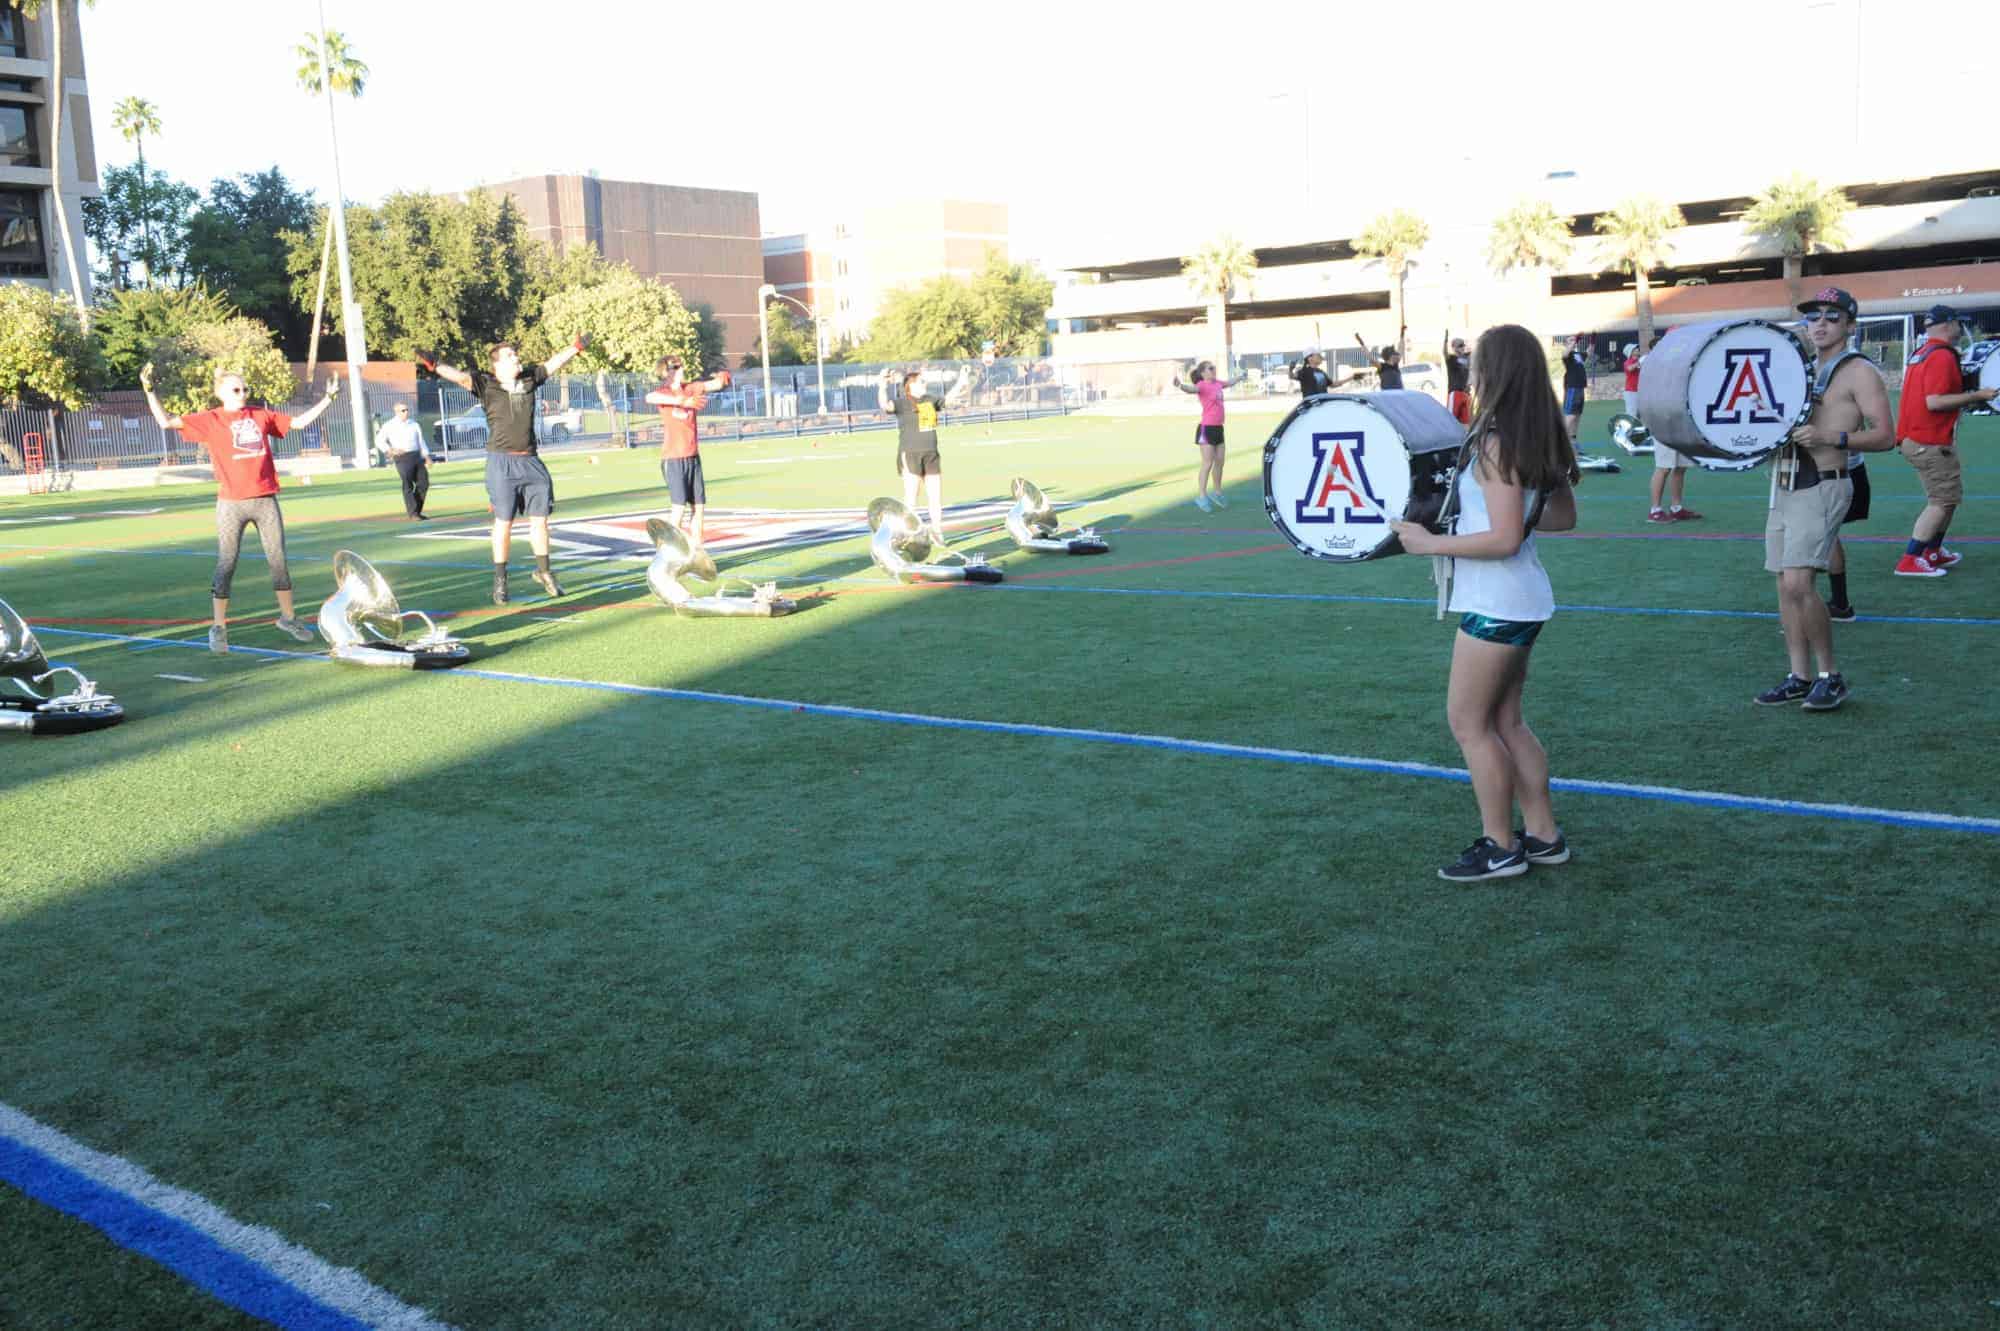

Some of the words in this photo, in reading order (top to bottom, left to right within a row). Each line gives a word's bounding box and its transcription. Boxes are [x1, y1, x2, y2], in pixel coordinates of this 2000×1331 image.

[1912, 287, 1953, 297] Entrance
[1706, 348, 1785, 424] A
[1296, 431, 1385, 523] A
